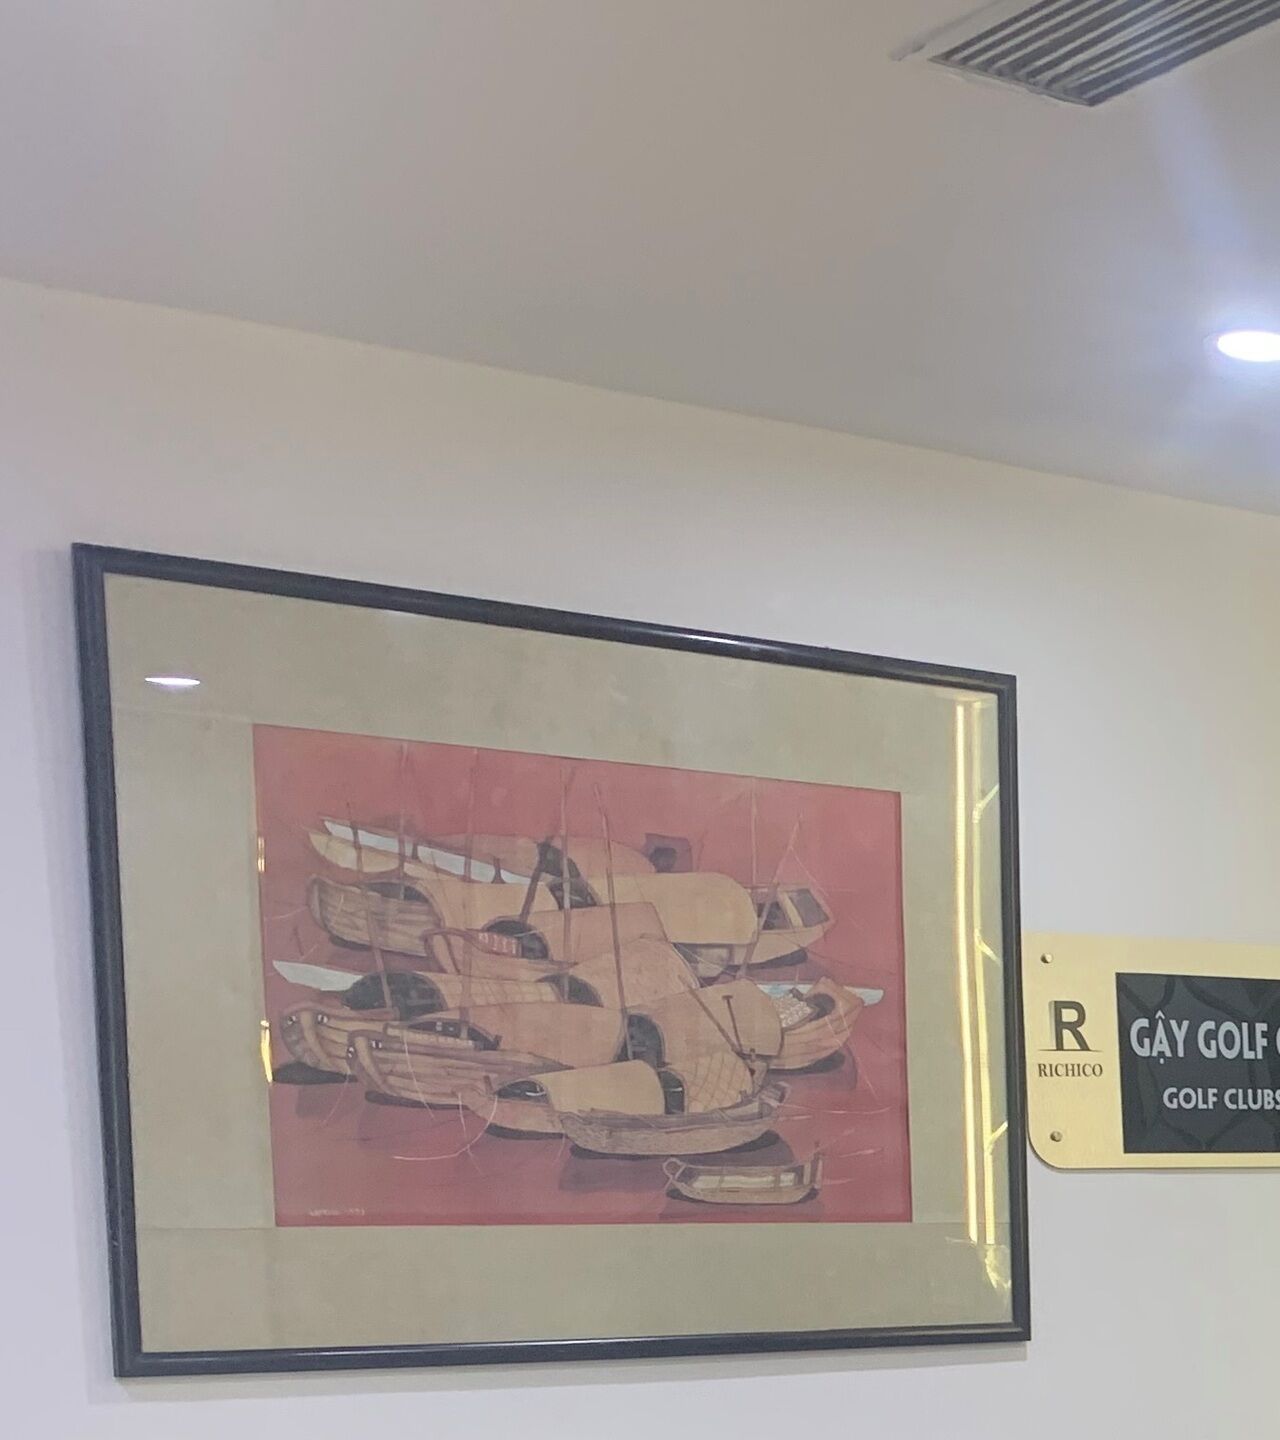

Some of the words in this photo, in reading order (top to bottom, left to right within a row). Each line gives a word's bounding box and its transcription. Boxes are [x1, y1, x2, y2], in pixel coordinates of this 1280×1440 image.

[1050, 1000, 1091, 1051] R
[1129, 1010, 1190, 1064] GẬY
[1197, 1020, 1268, 1060] GOLF
[1037, 1062, 1104, 1078] RICHICO
[1163, 1087, 1217, 1110] GOLF
